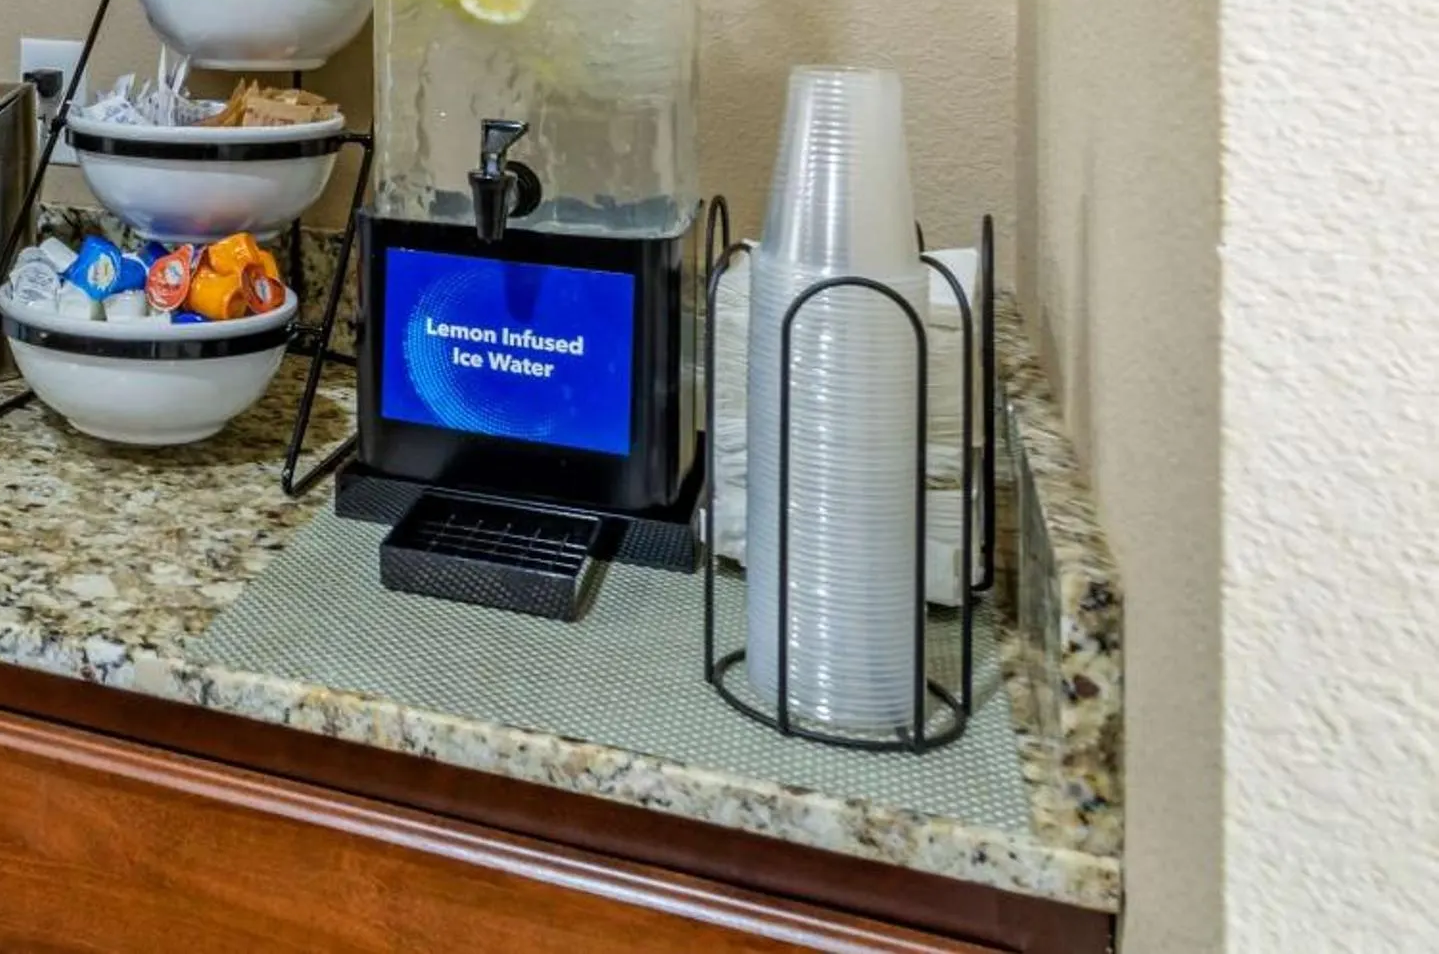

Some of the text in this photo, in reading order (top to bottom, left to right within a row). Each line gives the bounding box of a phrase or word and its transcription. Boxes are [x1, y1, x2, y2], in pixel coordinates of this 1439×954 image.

[426, 317, 584, 356] Lemon Infused
[452, 347, 555, 378] Ice Water
